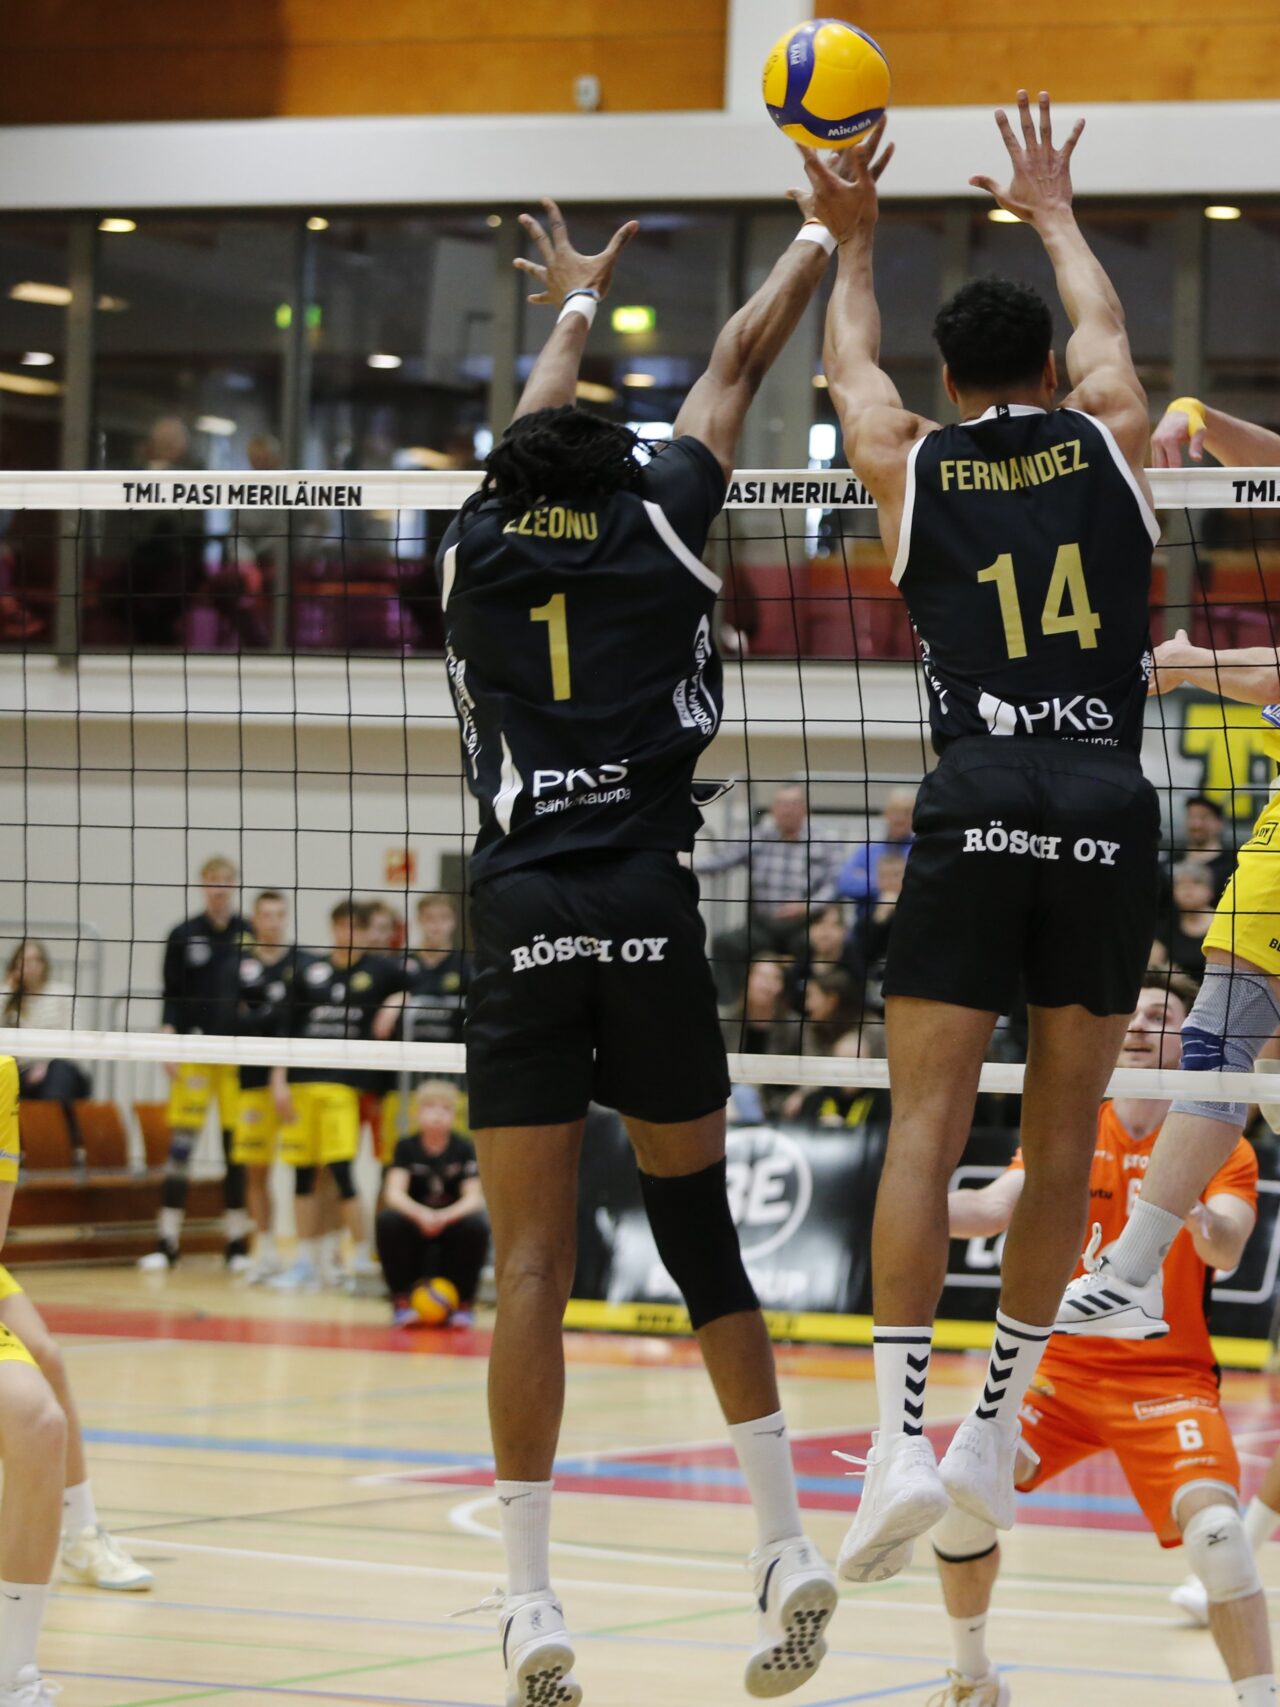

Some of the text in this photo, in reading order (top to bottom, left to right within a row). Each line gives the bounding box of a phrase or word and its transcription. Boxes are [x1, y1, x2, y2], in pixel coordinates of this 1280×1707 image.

[940, 439, 1089, 491] FERNANDEZ
[123, 481, 362, 506] TMI. PASI MERILÄINEN
[726, 478, 876, 505] ASI MERILÄI
[978, 542, 1101, 660] 14
[530, 593, 570, 700] 1
[1018, 695, 1114, 734] PKS
[962, 820, 1120, 865] RÖSCH OY
[621, 937, 669, 962] OY
[1176, 1419, 1204, 1451] 6
